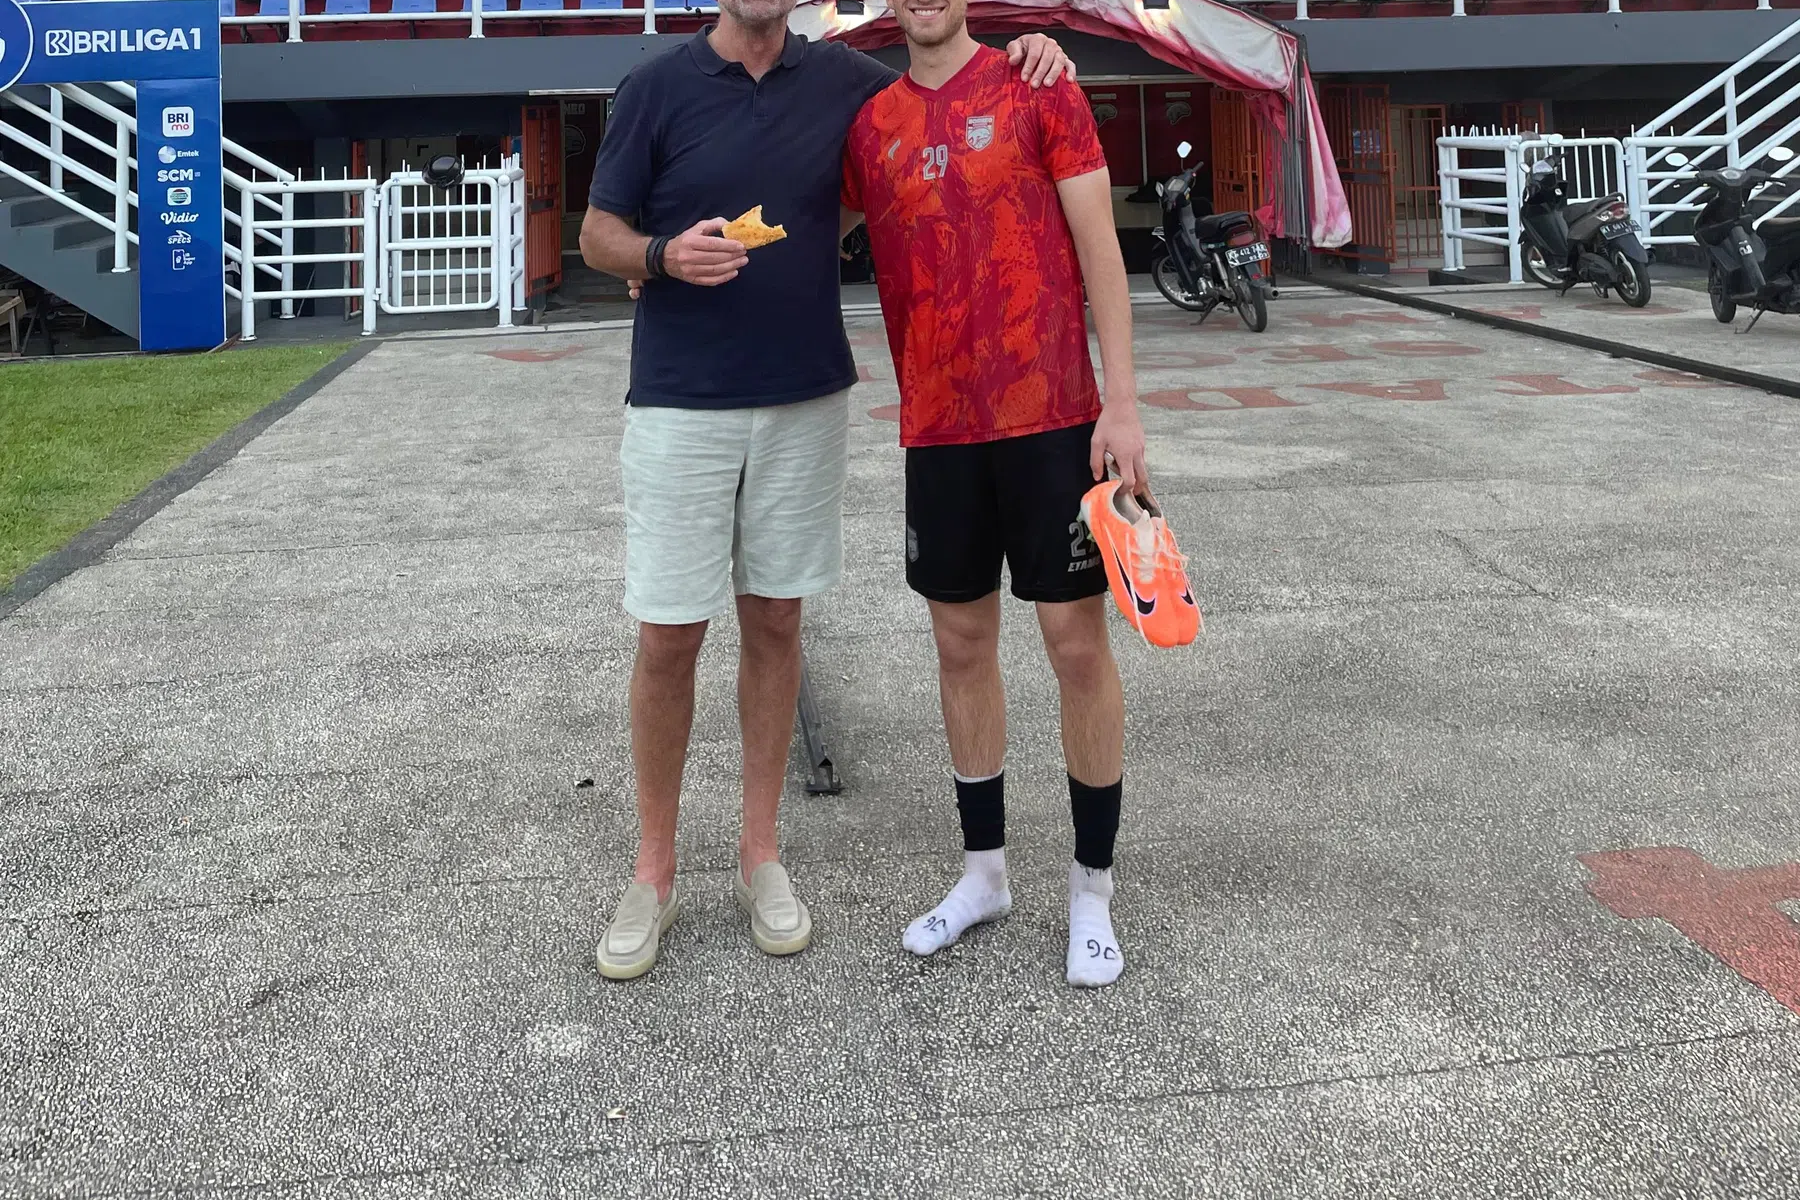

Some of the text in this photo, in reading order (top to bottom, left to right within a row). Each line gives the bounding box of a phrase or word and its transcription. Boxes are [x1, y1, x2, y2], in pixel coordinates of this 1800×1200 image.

[74, 29, 115, 53] BRI
[167, 112, 189, 124] BRI
[171, 123, 190, 131] mo
[177, 150, 200, 158] Emtek
[922, 144, 949, 181] 29
[157, 168, 194, 183] SCM
[160, 211, 200, 225] Vidio
[167, 237, 192, 245] SPECS
